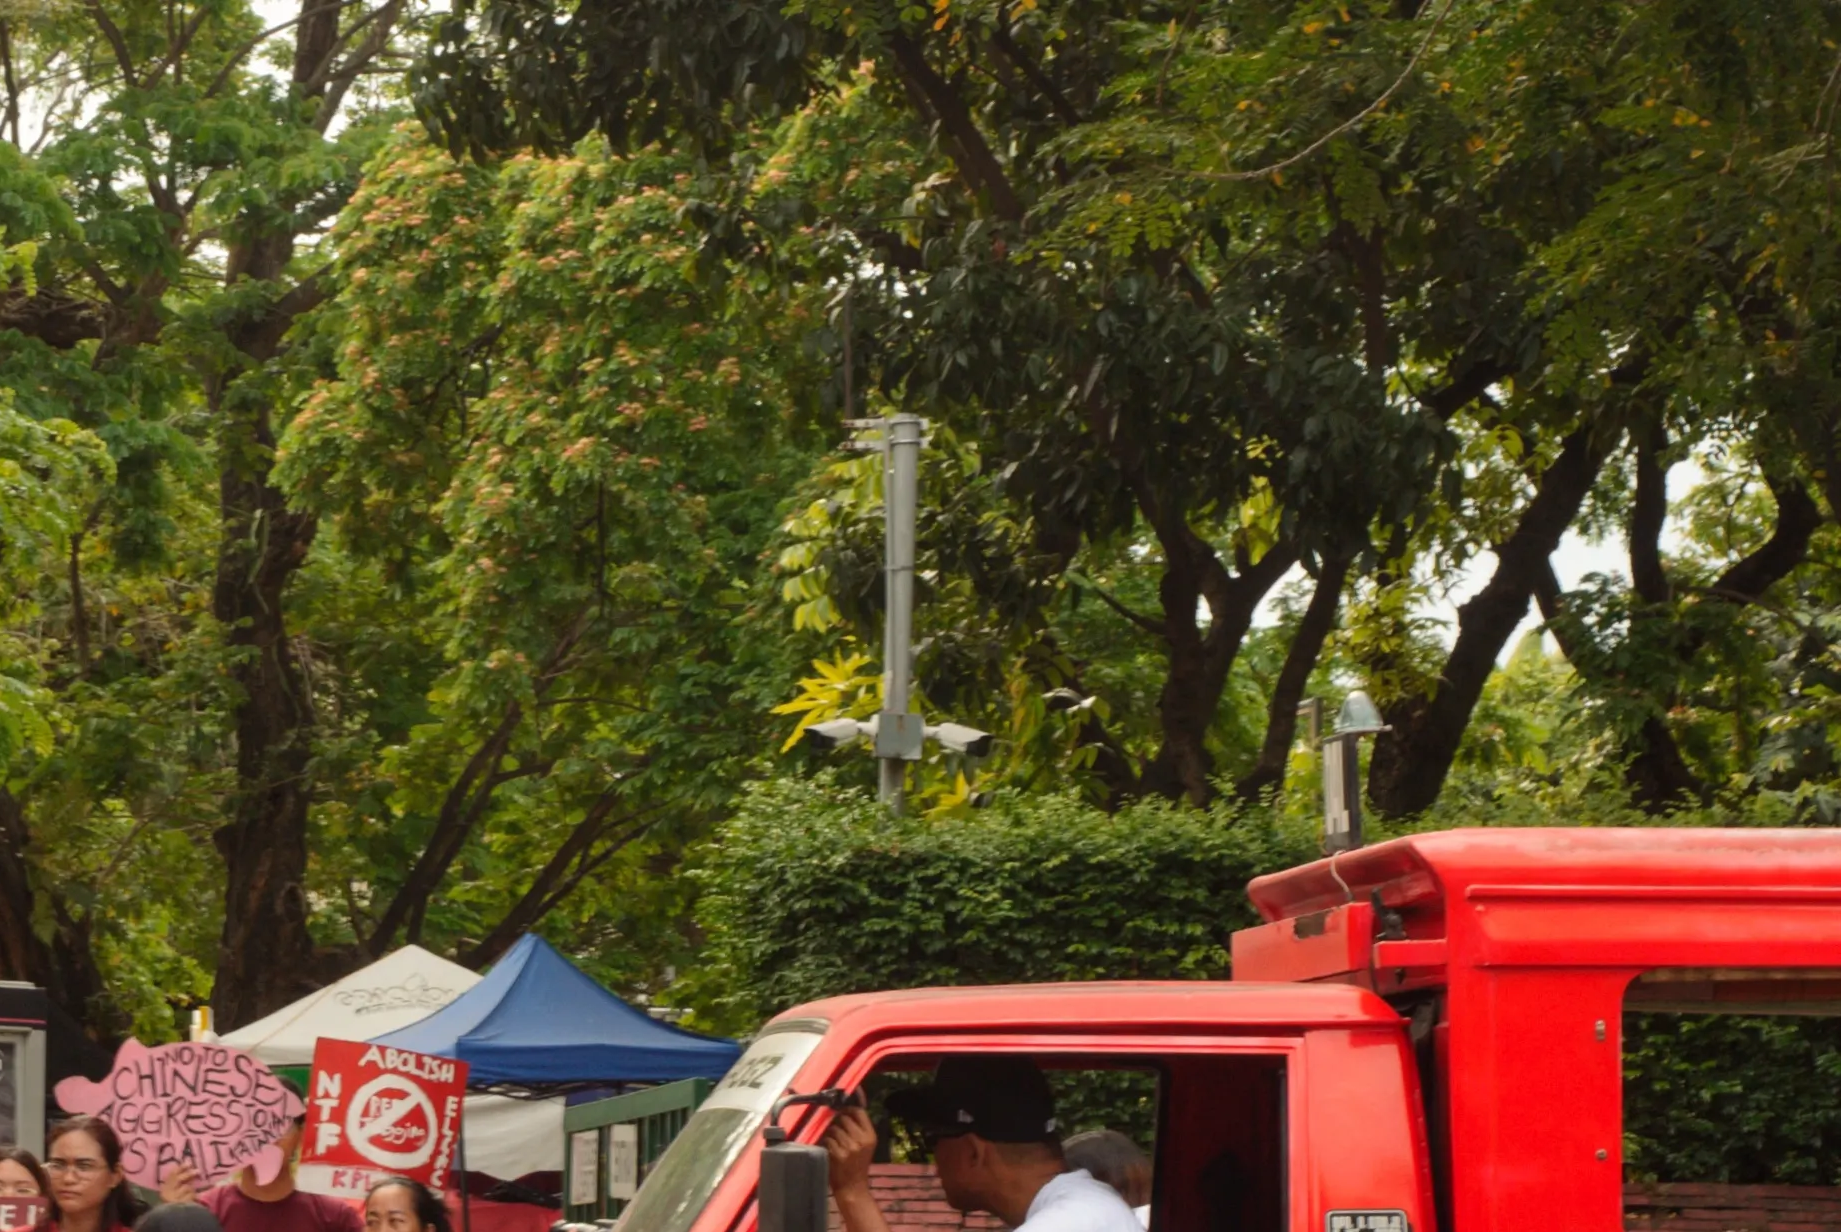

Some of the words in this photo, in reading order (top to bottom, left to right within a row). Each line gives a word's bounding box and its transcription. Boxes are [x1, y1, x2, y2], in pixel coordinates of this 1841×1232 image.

[164, 1046, 196, 1066] NO
[203, 1047, 228, 1066] TO
[358, 1045, 455, 1083] ABOLISH
[113, 1054, 279, 1105] CHINESE
